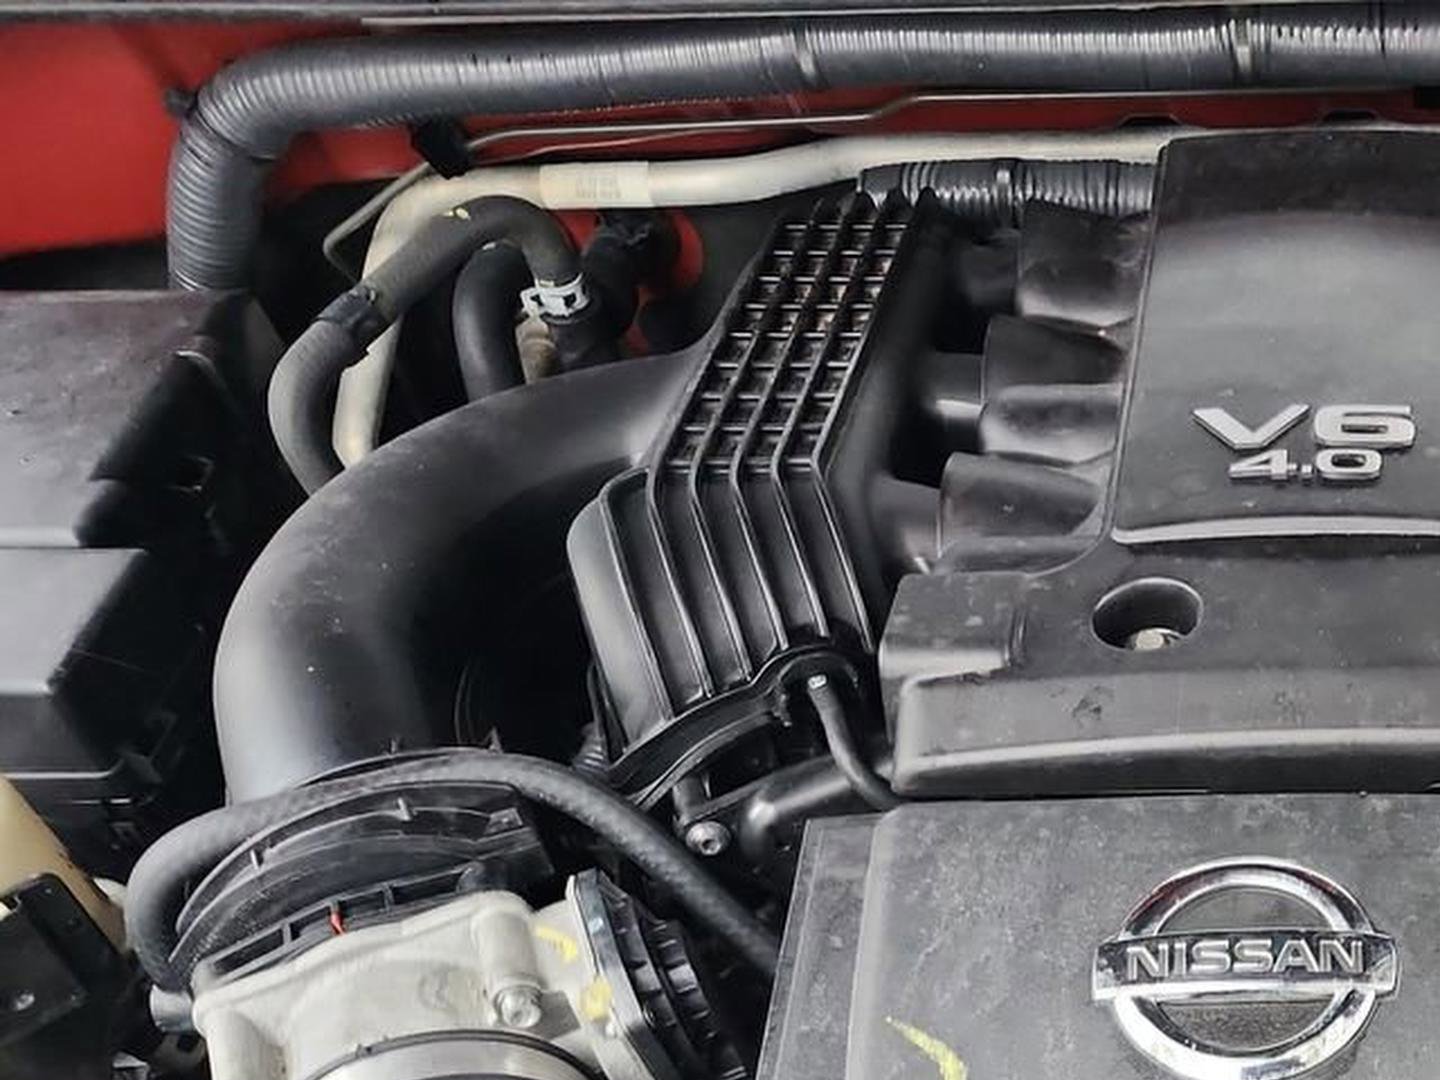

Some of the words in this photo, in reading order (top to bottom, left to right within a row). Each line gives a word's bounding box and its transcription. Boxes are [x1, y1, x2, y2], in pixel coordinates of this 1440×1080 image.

[1192, 403, 1417, 449] V6
[1227, 448, 1383, 481] 4.0
[1125, 938, 1365, 981] NISSAN
